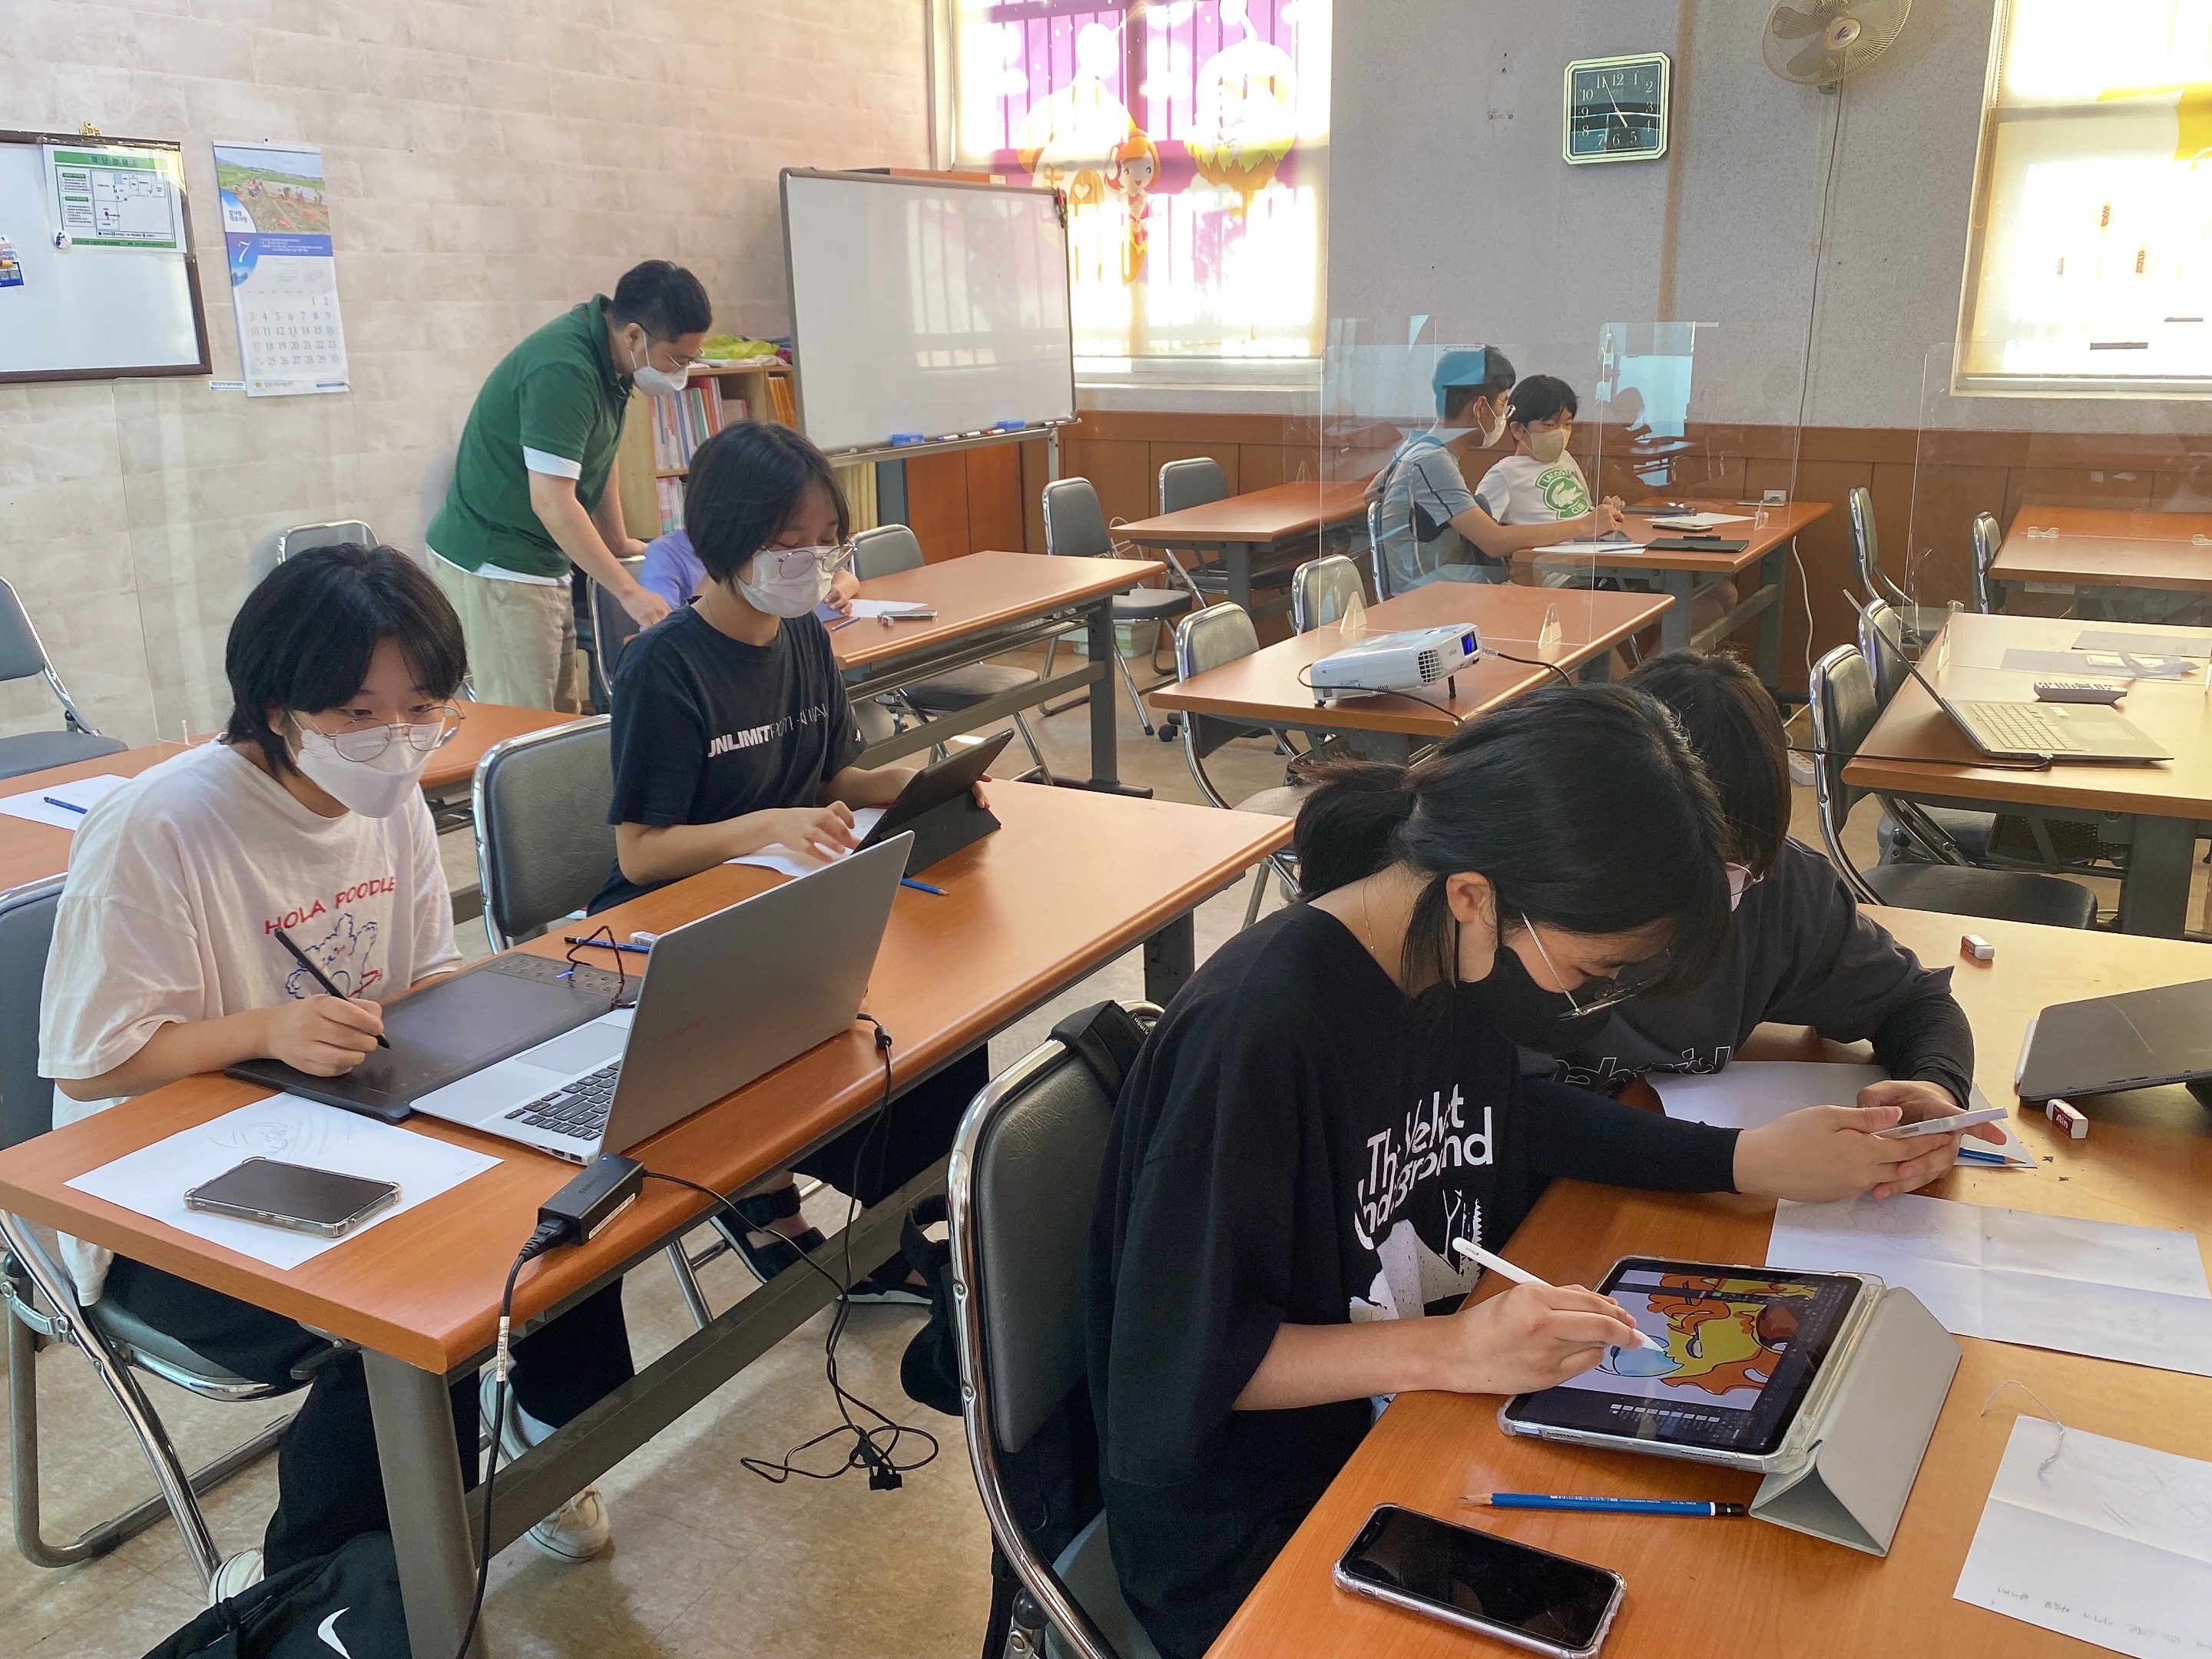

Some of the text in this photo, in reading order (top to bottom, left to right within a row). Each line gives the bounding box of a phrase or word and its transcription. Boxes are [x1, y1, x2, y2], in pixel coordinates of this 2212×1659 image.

[1612, 73, 1624, 86] 12
[1633, 72, 1638, 85] 1
[1645, 80, 1653, 93] 2
[1581, 88, 1594, 101] 10
[1581, 106, 1589, 118] 9
[1645, 101, 1654, 113] 3
[1581, 124, 1589, 137] 8
[1645, 119, 1651, 132] 4
[1598, 134, 1604, 146] 7
[1612, 133, 1620, 147] 6
[1630, 131, 1637, 144] 5
[238, 240, 250, 263] 7
[323, 296, 329, 306] 2
[263, 312, 268, 321] 4
[276, 312, 280, 320] 5
[300, 311, 306, 320] 7
[313, 311, 319, 320] 8
[250, 326, 335, 336] 10 11 12 13 14 15 16
[266, 342, 274, 350] 18
[278, 342, 286, 350] 19
[291, 341, 300, 349] 20
[303, 341, 311, 349] 21
[315, 340, 324, 349] 22
[327, 340, 336, 349] 23
[267, 356, 276, 365] 25
[280, 356, 289, 365] 26
[293, 356, 300, 364] 27
[305, 356, 313, 364] 28
[317, 355, 326, 363] 29
[265, 876, 395, 934] HOLA POODLE
[2055, 1114, 2068, 1129] Ain
[1366, 1128, 1401, 1195] Th
